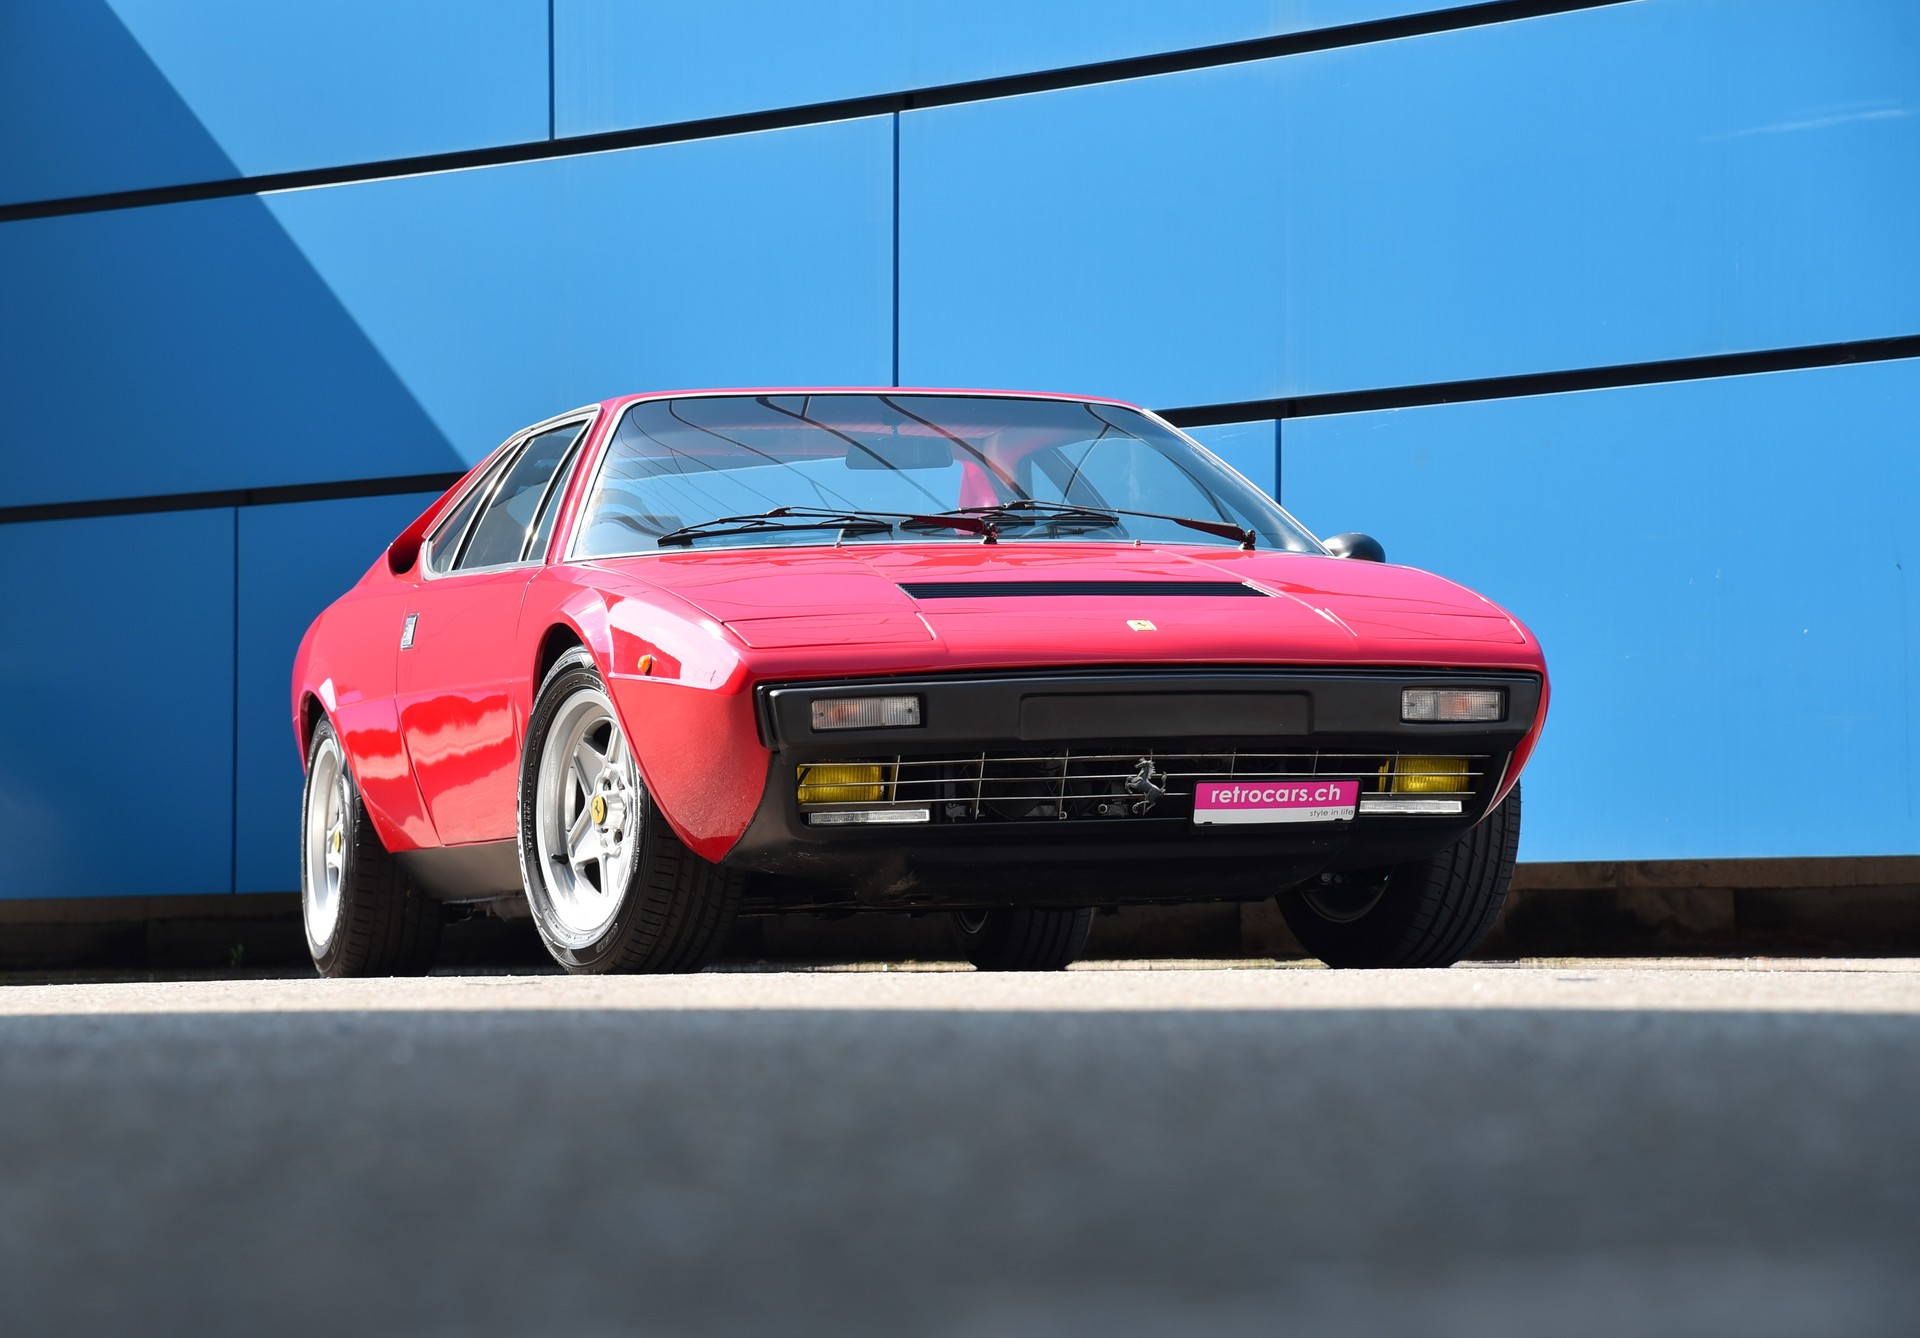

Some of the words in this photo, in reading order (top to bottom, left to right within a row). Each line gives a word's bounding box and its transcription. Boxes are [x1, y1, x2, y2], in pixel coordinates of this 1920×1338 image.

[1211, 784, 1341, 803] retrocars.ch
[1309, 809, 1329, 818] style
[1330, 808, 1339, 816] in
[1340, 808, 1354, 816] life
